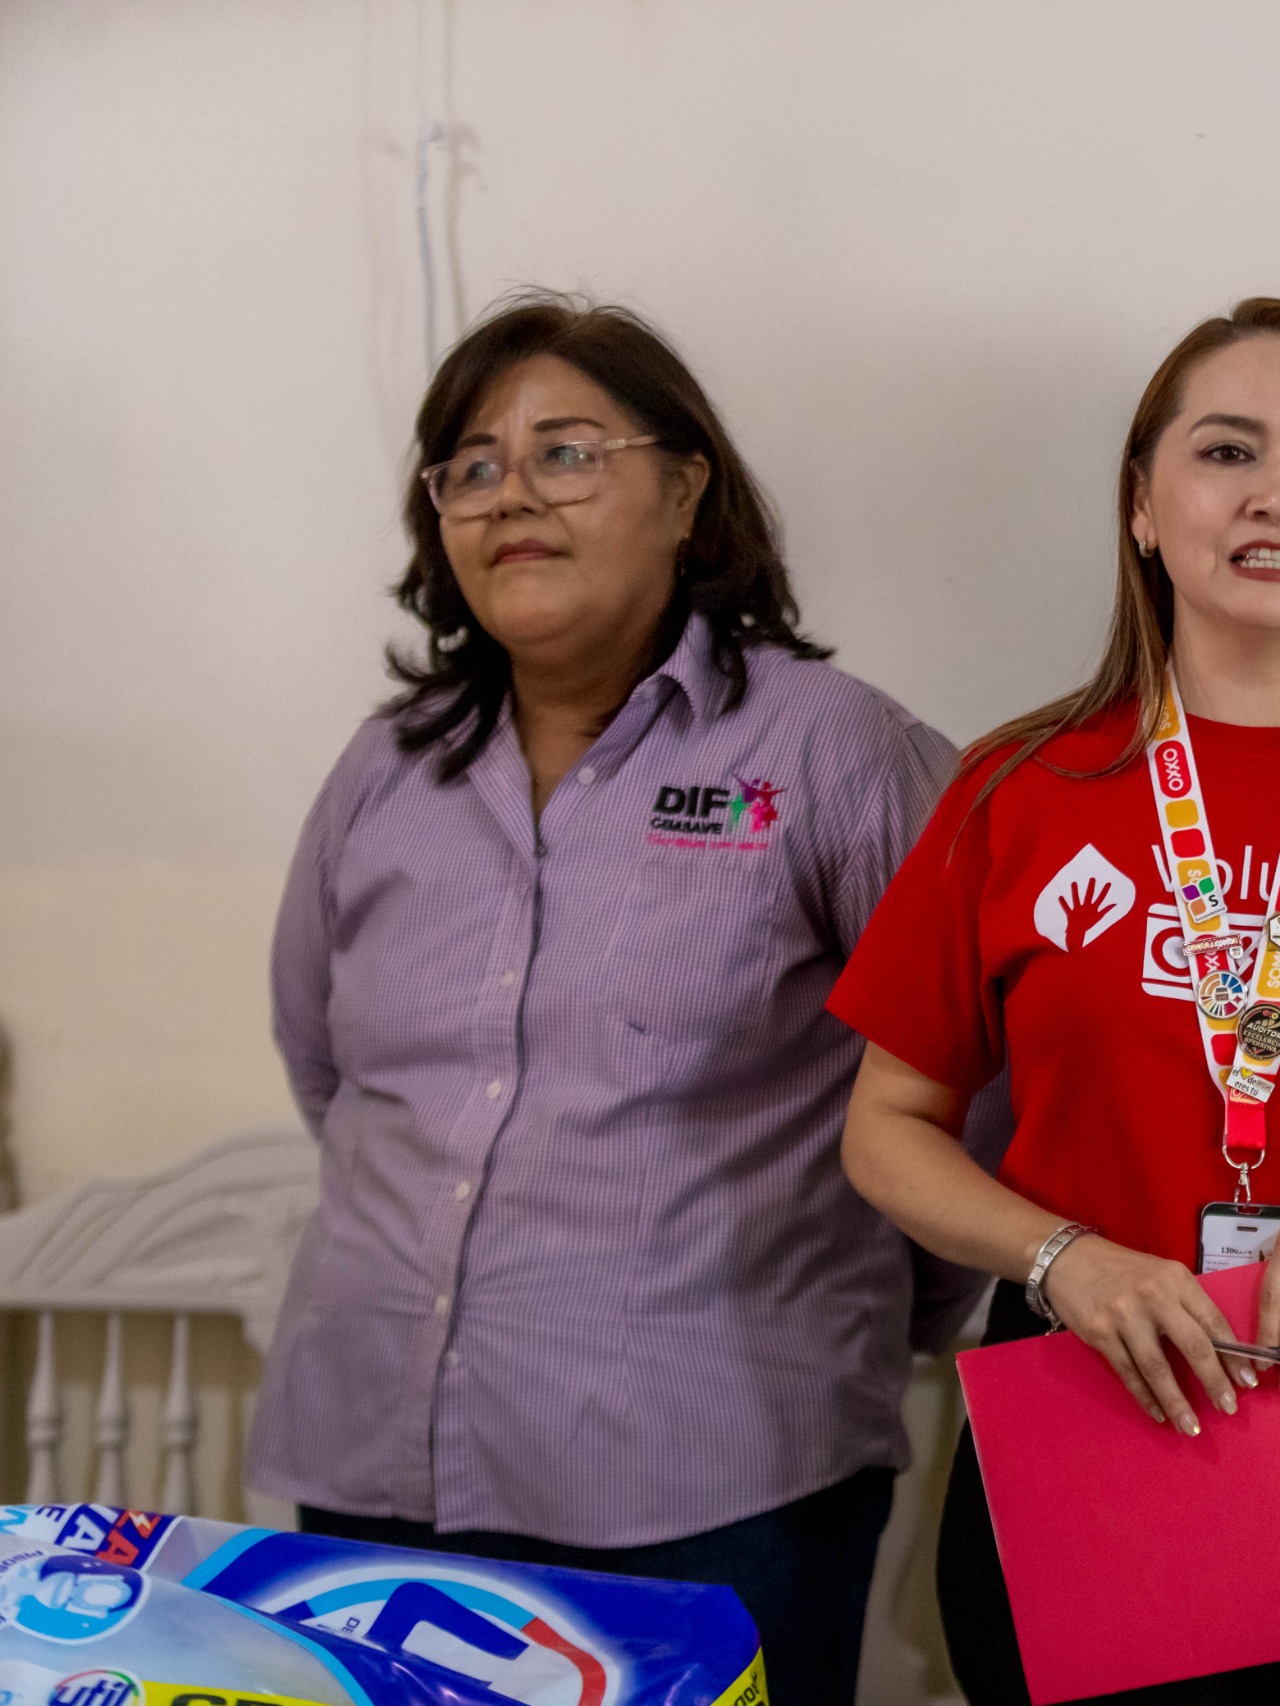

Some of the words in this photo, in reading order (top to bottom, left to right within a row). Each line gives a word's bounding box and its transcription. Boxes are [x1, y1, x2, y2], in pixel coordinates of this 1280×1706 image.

[1163, 747, 1184, 792] OXXO
[653, 786, 730, 818] DIF
[1208, 894, 1219, 908] S
[1235, 1080, 1250, 1094] eres
